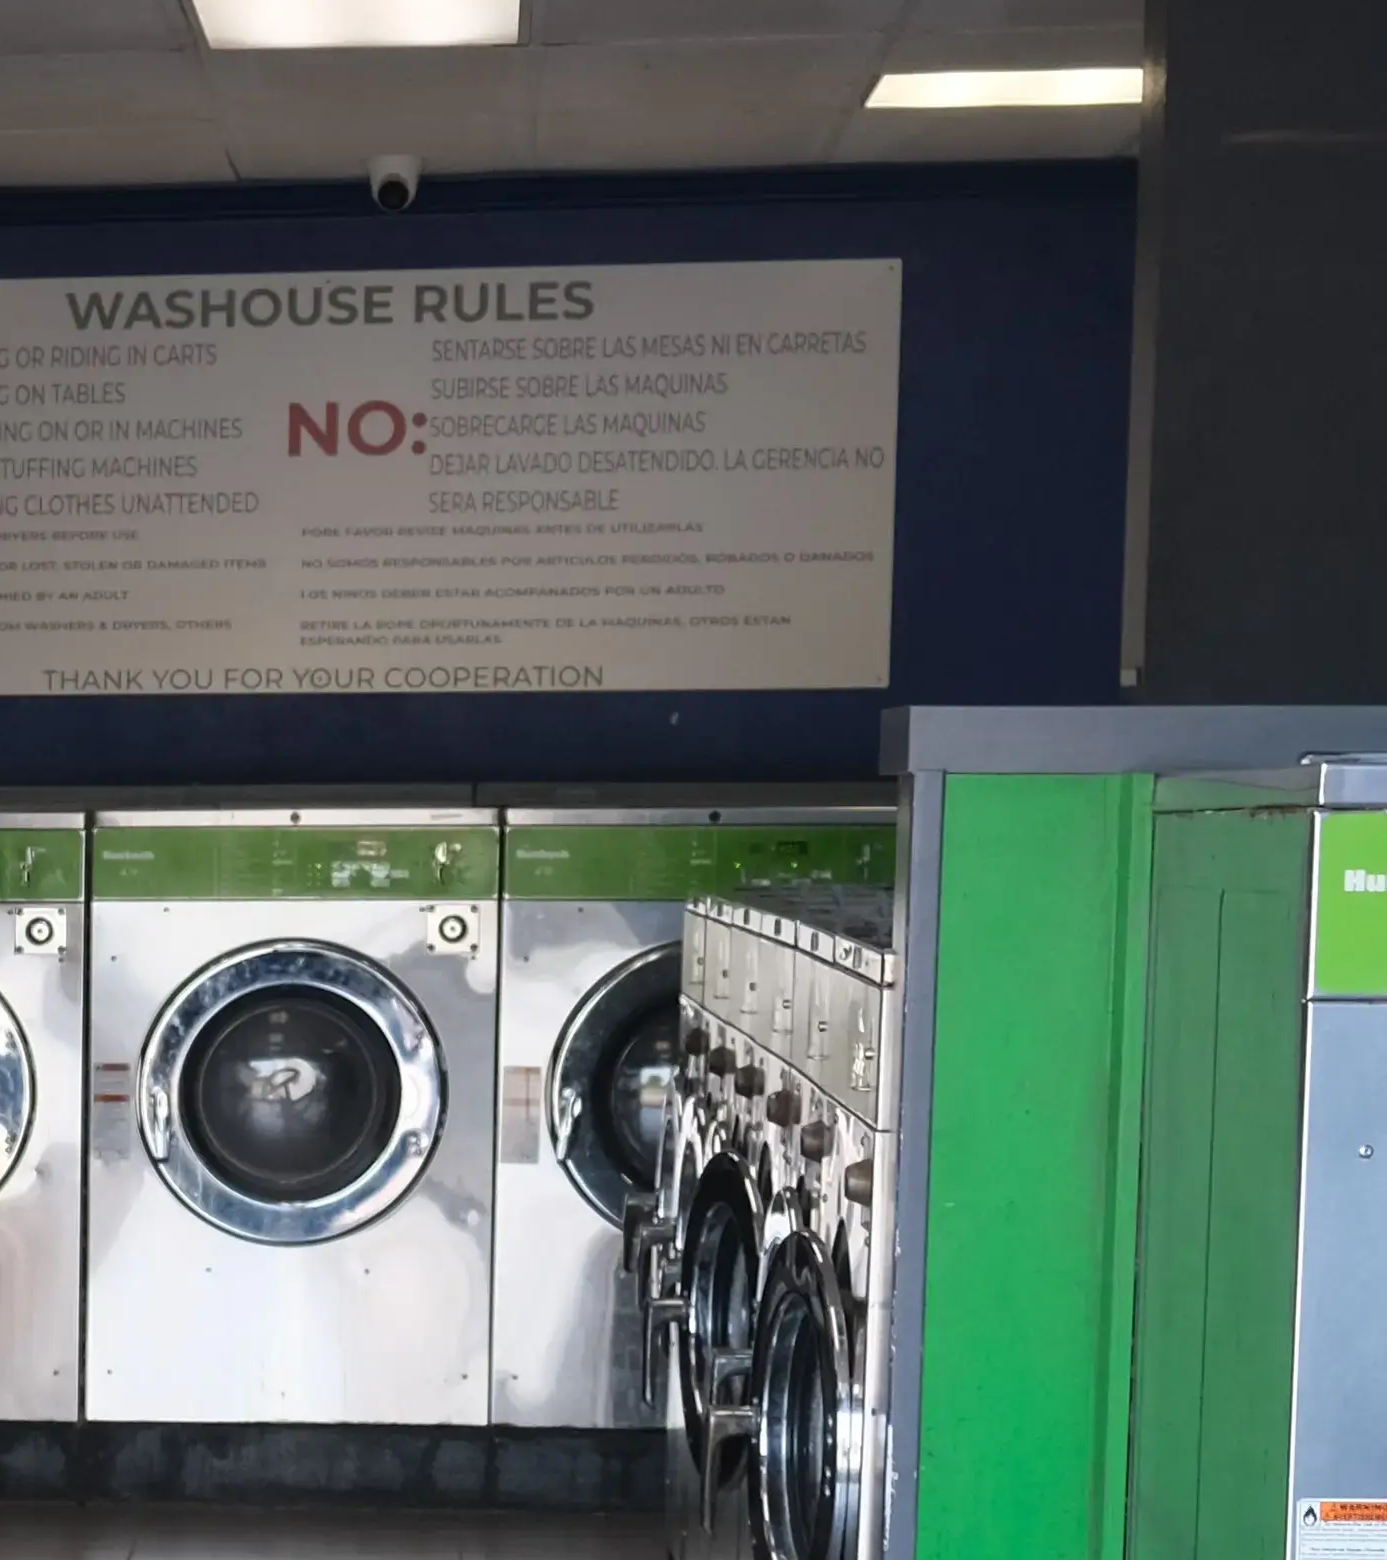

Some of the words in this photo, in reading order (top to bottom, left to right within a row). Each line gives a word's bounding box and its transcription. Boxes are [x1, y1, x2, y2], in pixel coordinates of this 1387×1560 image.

[65, 286, 394, 329] WASHOUSE
[414, 281, 594, 324] RULES
[16, 347, 45, 368] OR
[50, 346, 121, 368] RIDING
[127, 345, 147, 366] IN
[153, 344, 217, 365] CARTS
[432, 337, 527, 361] SENTARSE
[532, 336, 596, 359] SOBRE
[602, 336, 637, 358] LAS
[642, 335, 706, 358] MESAS
[711, 334, 731, 356] NI
[735, 334, 762, 356] EN
[766, 332, 866, 356] CARRETAS
[15, 384, 45, 405] ON
[51, 383, 125, 404] TABLES
[431, 377, 511, 399] SUBIRSE
[516, 376, 579, 398] SOBRE
[586, 375, 619, 397] LAS
[625, 373, 728, 396] MAQUINAS
[37, 420, 68, 442] ON
[74, 420, 103, 442] OR
[110, 419, 129, 441] IN
[136, 418, 243, 441] MACHINES
[288, 400, 427, 457] NO:
[428, 414, 559, 438] SOBRECARGE
[563, 414, 597, 436] LAS
[603, 412, 707, 436] MAQUINAS
[92, 456, 197, 478] MACHINES
[428, 454, 490, 476] DEJAR
[495, 452, 572, 475] LAVADO
[724, 449, 748, 471] LA
[752, 448, 849, 470] GERENCIA
[854, 447, 885, 469] NO
[24, 494, 116, 516] CLOTHES
[121, 492, 260, 515] UNATTENDED
[429, 492, 477, 514] SERA
[482, 490, 619, 513] RESPONSABLE
[41, 669, 143, 690] THANK
[152, 668, 212, 689] YOU
[224, 668, 283, 689] FOR
[292, 667, 375, 689] YOUR
[384, 665, 603, 688] COOPERATION
[1344, 870, 1387, 892] Hu
